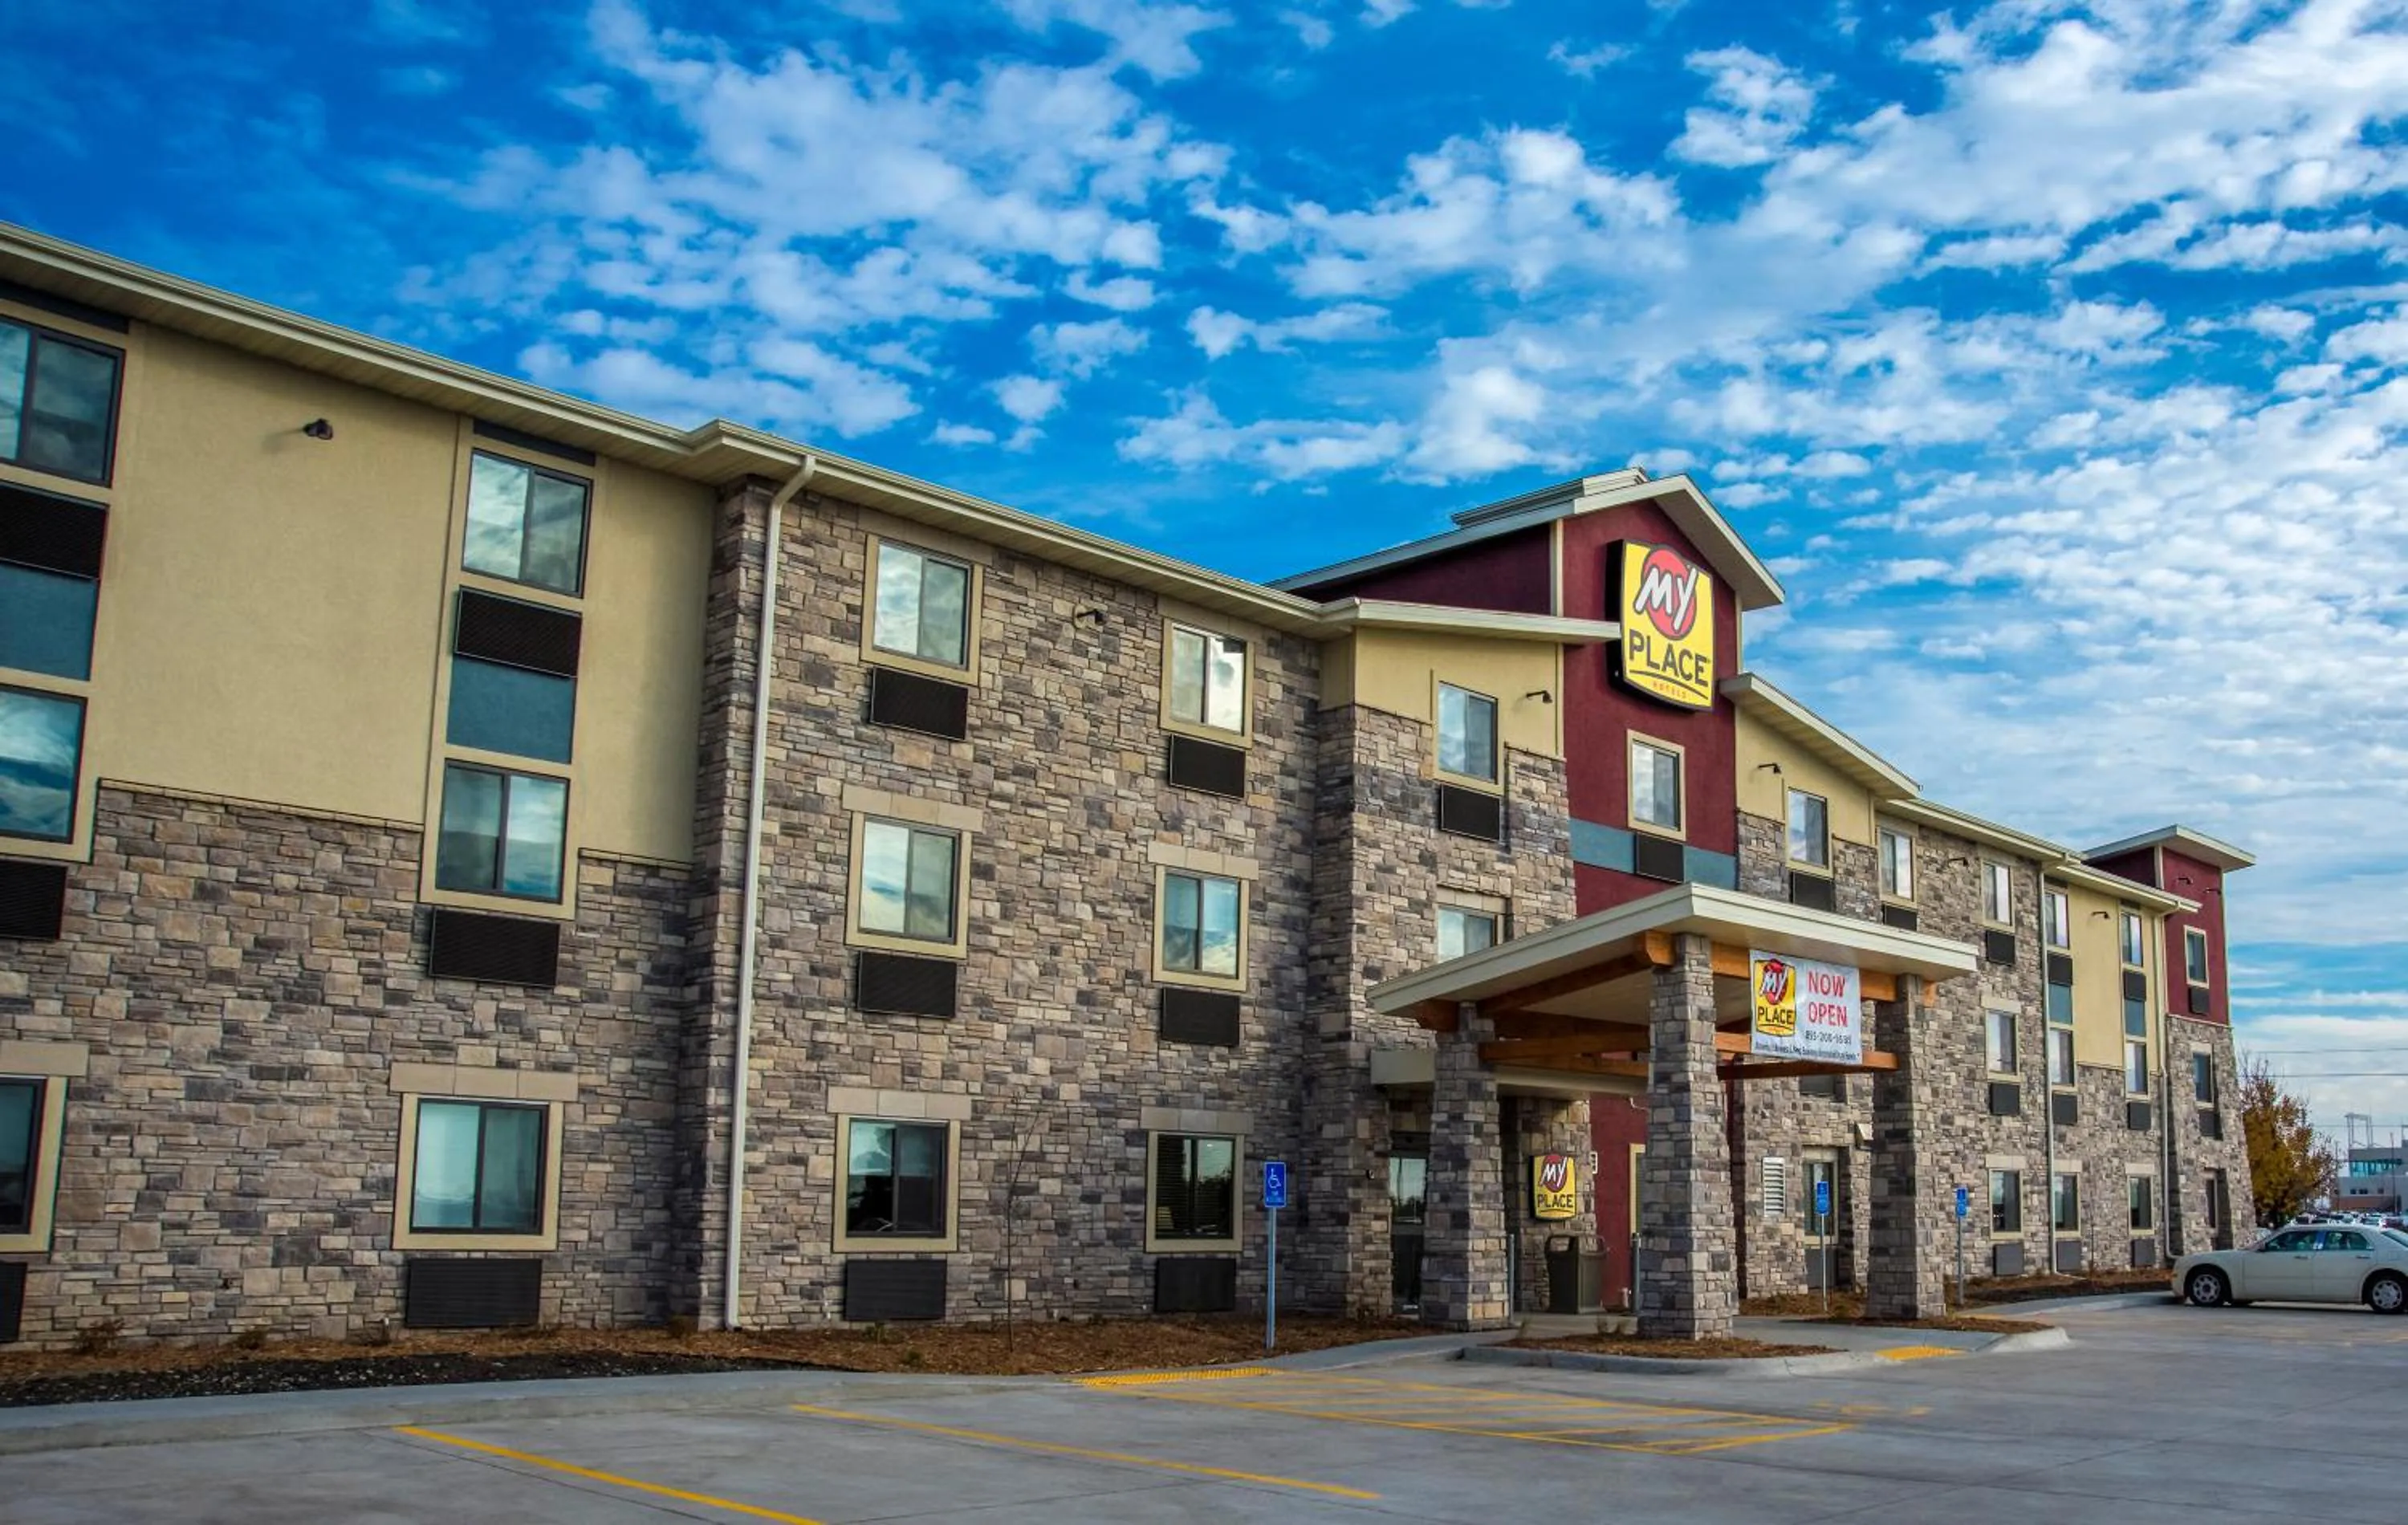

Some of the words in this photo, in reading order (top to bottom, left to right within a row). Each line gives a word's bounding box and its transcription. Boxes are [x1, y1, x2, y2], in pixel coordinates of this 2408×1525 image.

[1629, 628, 1709, 687] PLACE
[1808, 971, 1846, 998] NOW
[1757, 1007, 1795, 1025] PLACE
[1808, 1002, 1849, 1027] OPEN
[1537, 1194, 1574, 1208] PLACE
